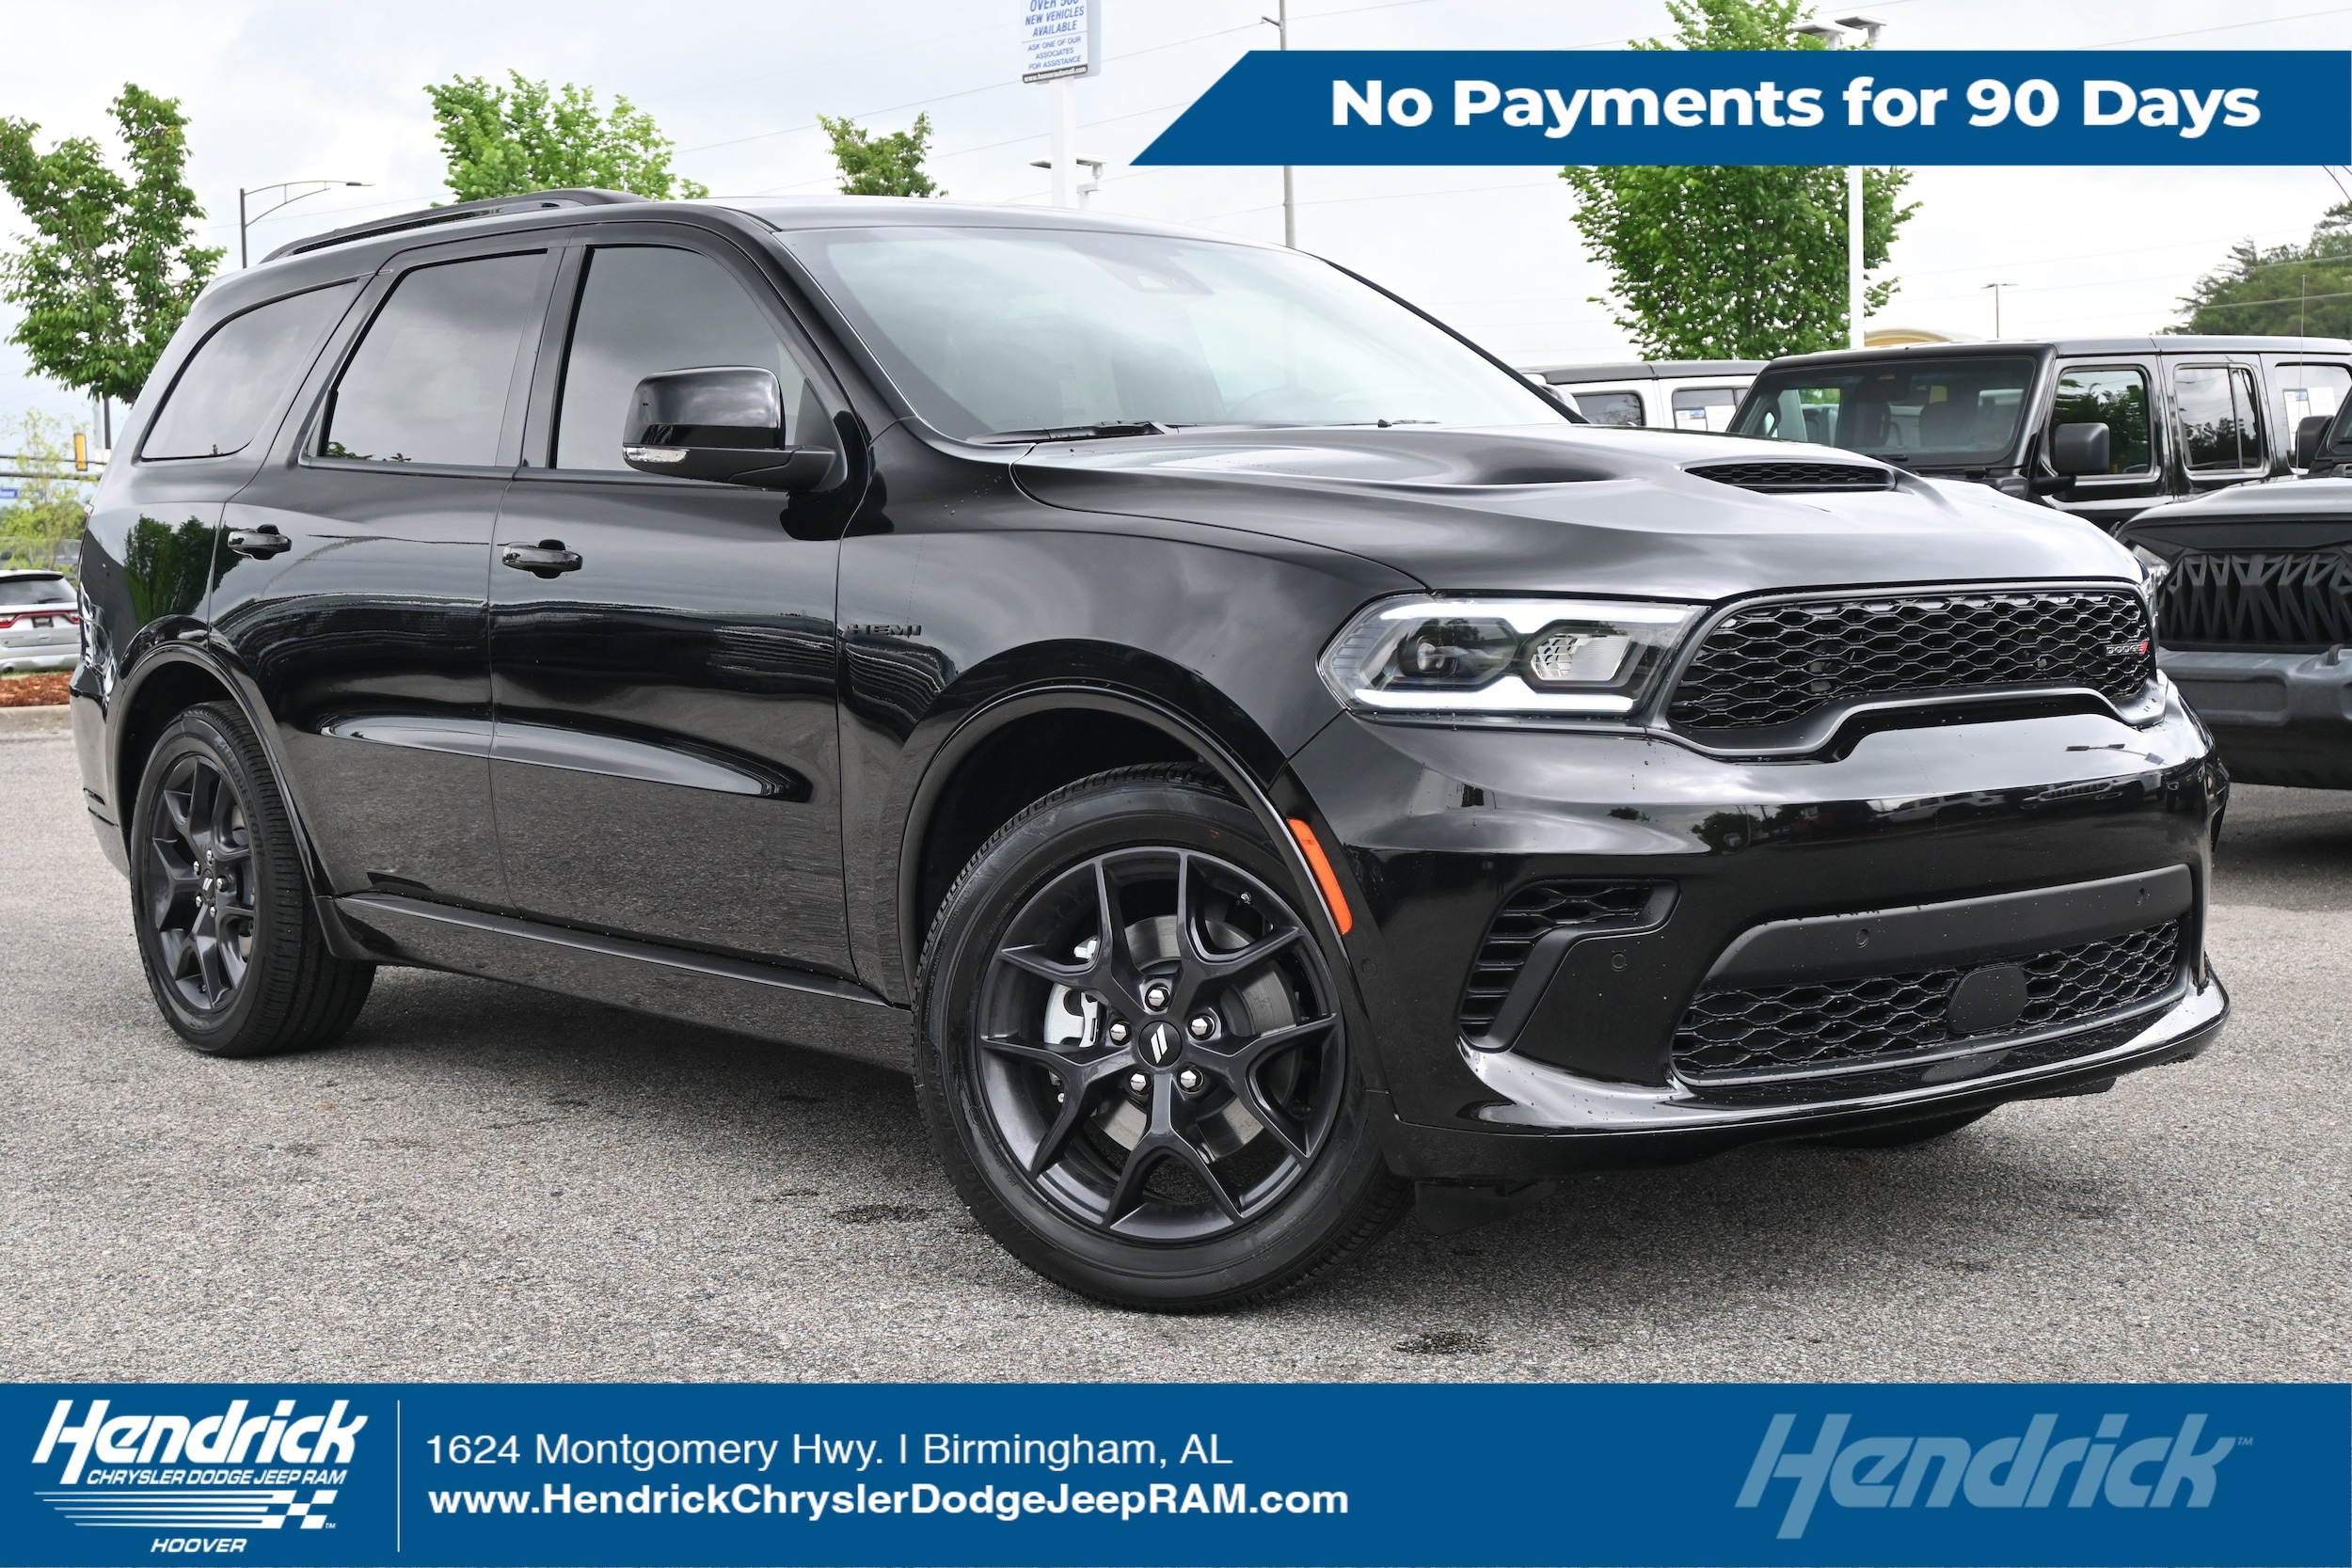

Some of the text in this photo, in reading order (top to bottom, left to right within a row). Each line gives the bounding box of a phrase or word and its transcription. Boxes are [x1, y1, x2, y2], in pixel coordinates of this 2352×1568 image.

[1025, 6, 1085, 25] NEW VEHICLES
[1033, 20, 1078, 37] AVAILABLE
[1068, 36, 1082, 44] OUR
[1035, 47, 1073, 59] ASSOCIATES
[1042, 55, 1082, 68] ASSISTANCE
[848, 624, 921, 636] HEMI
[2106, 643, 2143, 655] DODGE
